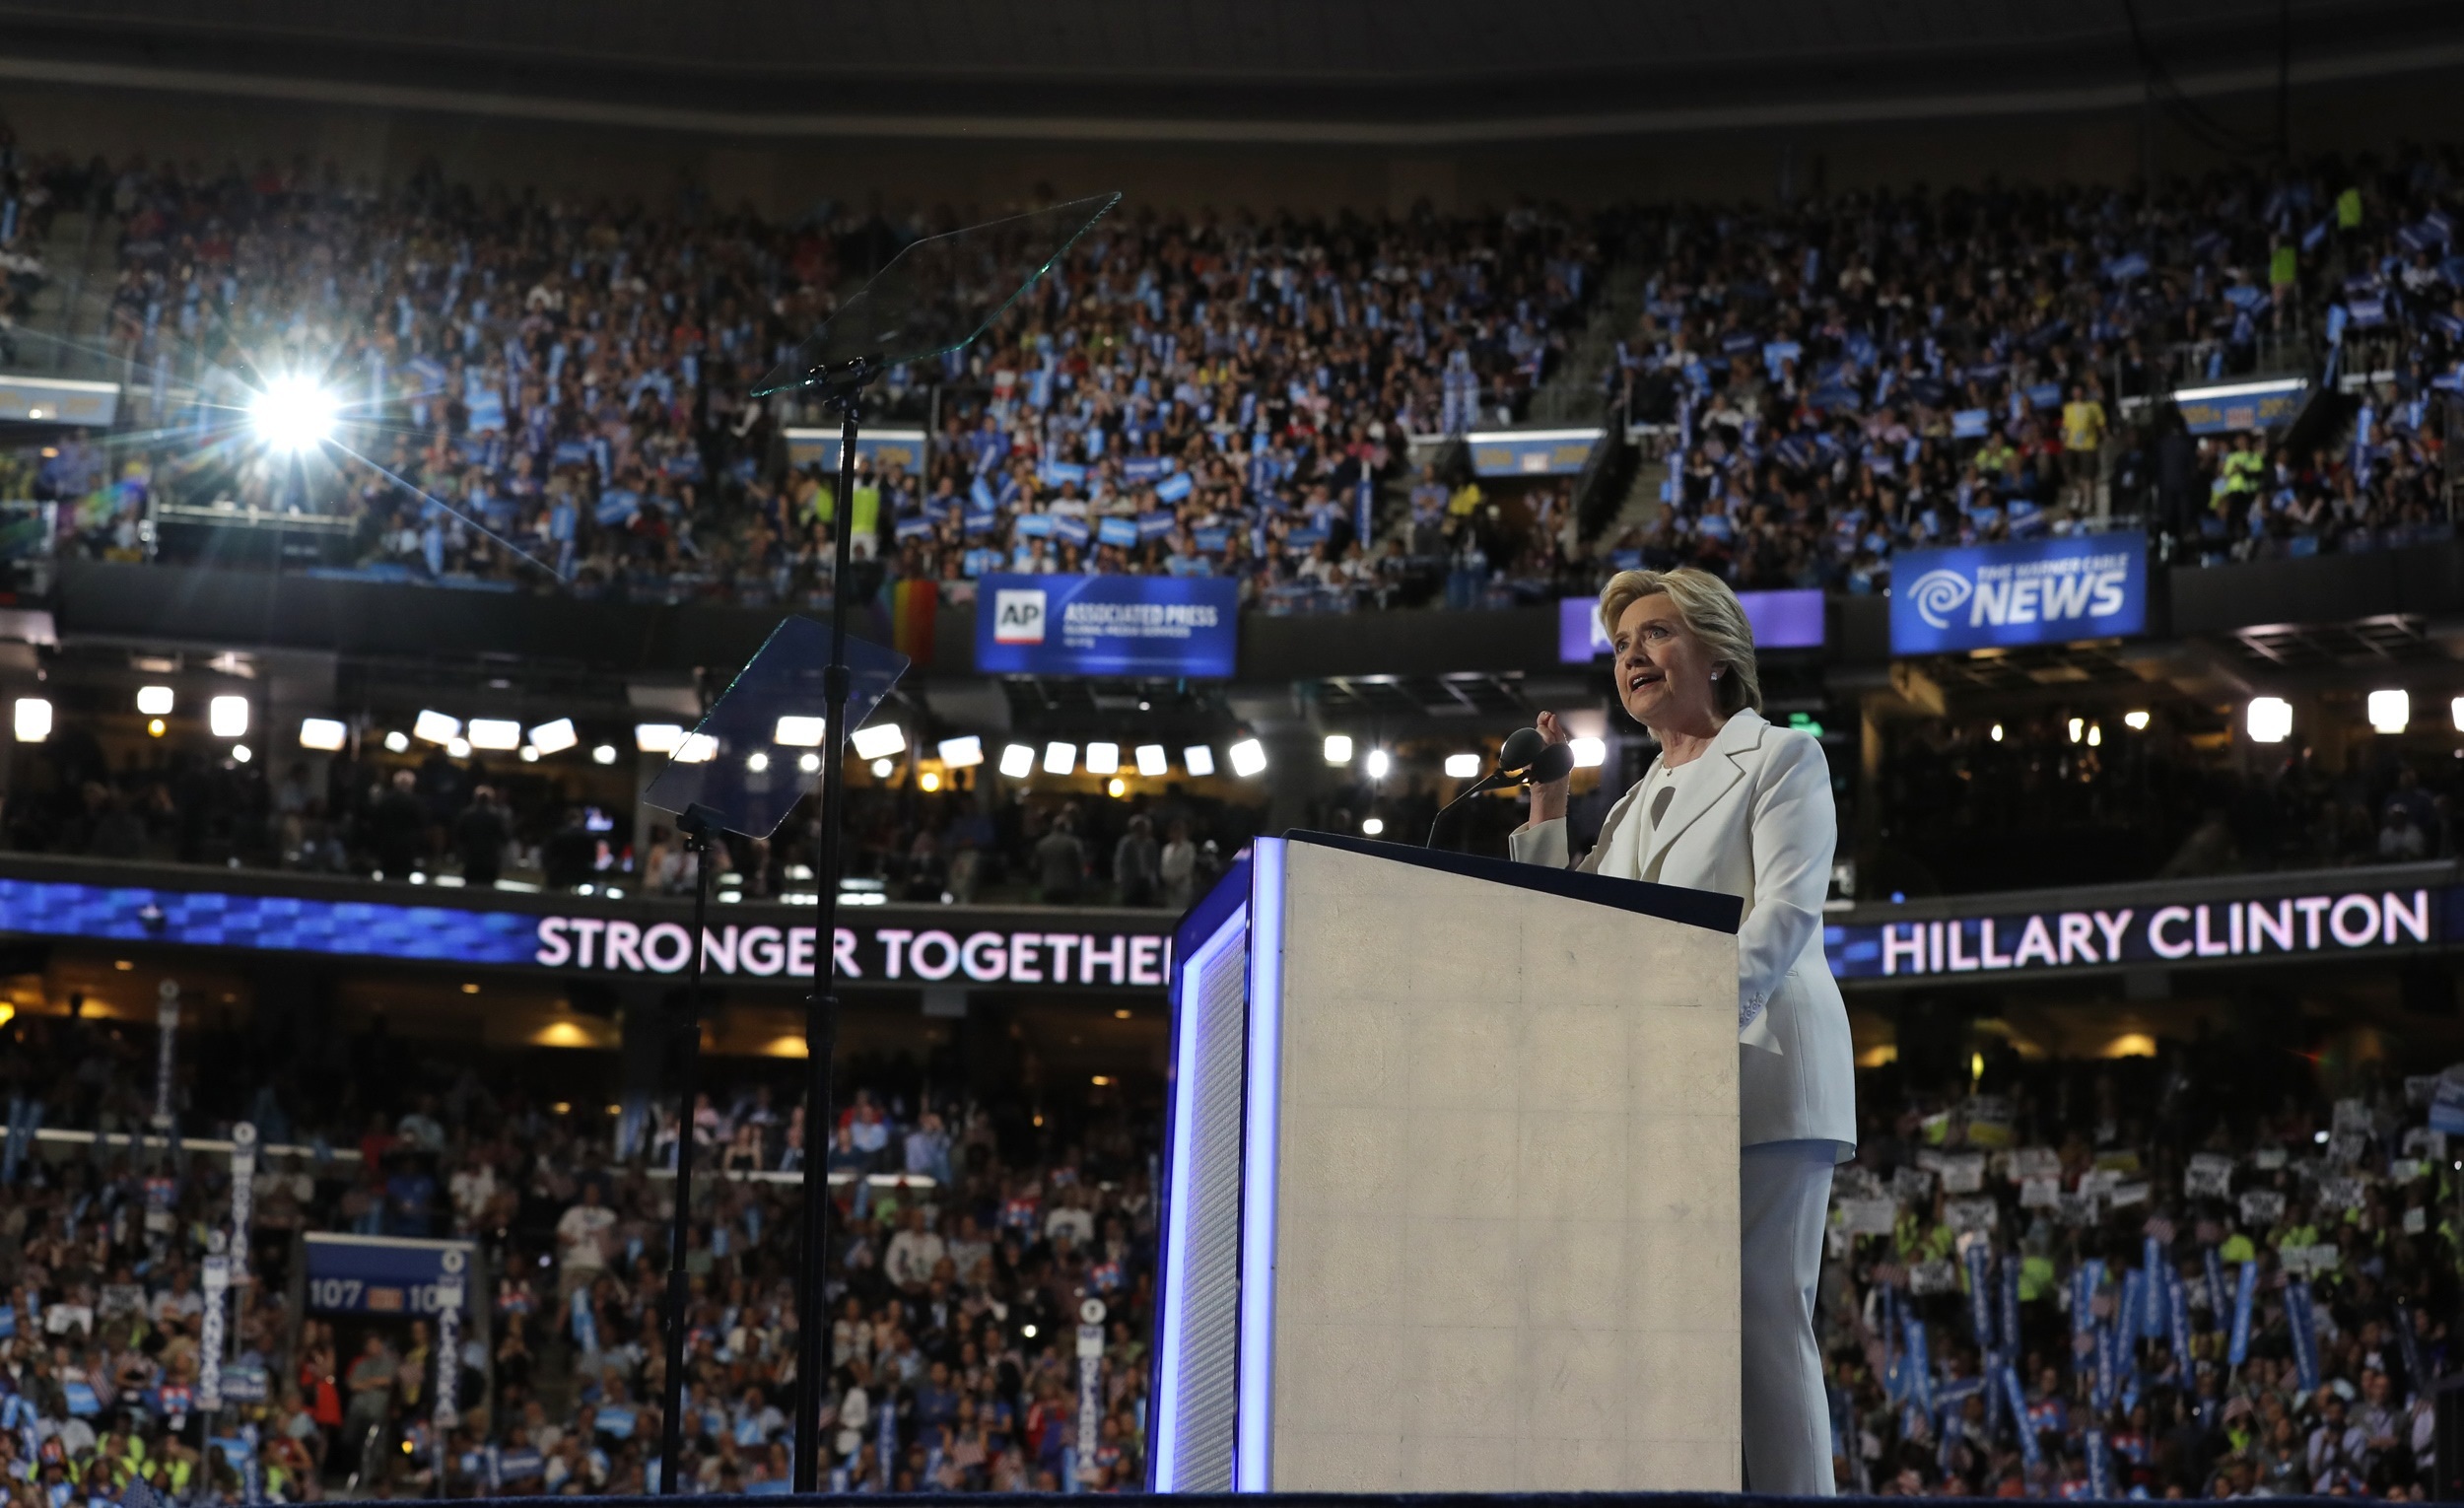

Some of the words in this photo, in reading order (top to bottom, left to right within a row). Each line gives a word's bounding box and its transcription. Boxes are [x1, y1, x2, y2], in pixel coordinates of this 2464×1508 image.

[1002, 604, 1039, 626] AP
[1062, 602, 1164, 625] ASSOCIATED
[1165, 604, 1219, 627] PRESS
[1969, 571, 2127, 628] NEWS
[535, 916, 862, 978] STRONGER
[875, 928, 1173, 986] TOGETHE
[1882, 909, 2133, 975] HILLARY
[2148, 889, 2430, 959] CLINTON
[310, 1279, 363, 1308] 107
[409, 1284, 442, 1314] 10
